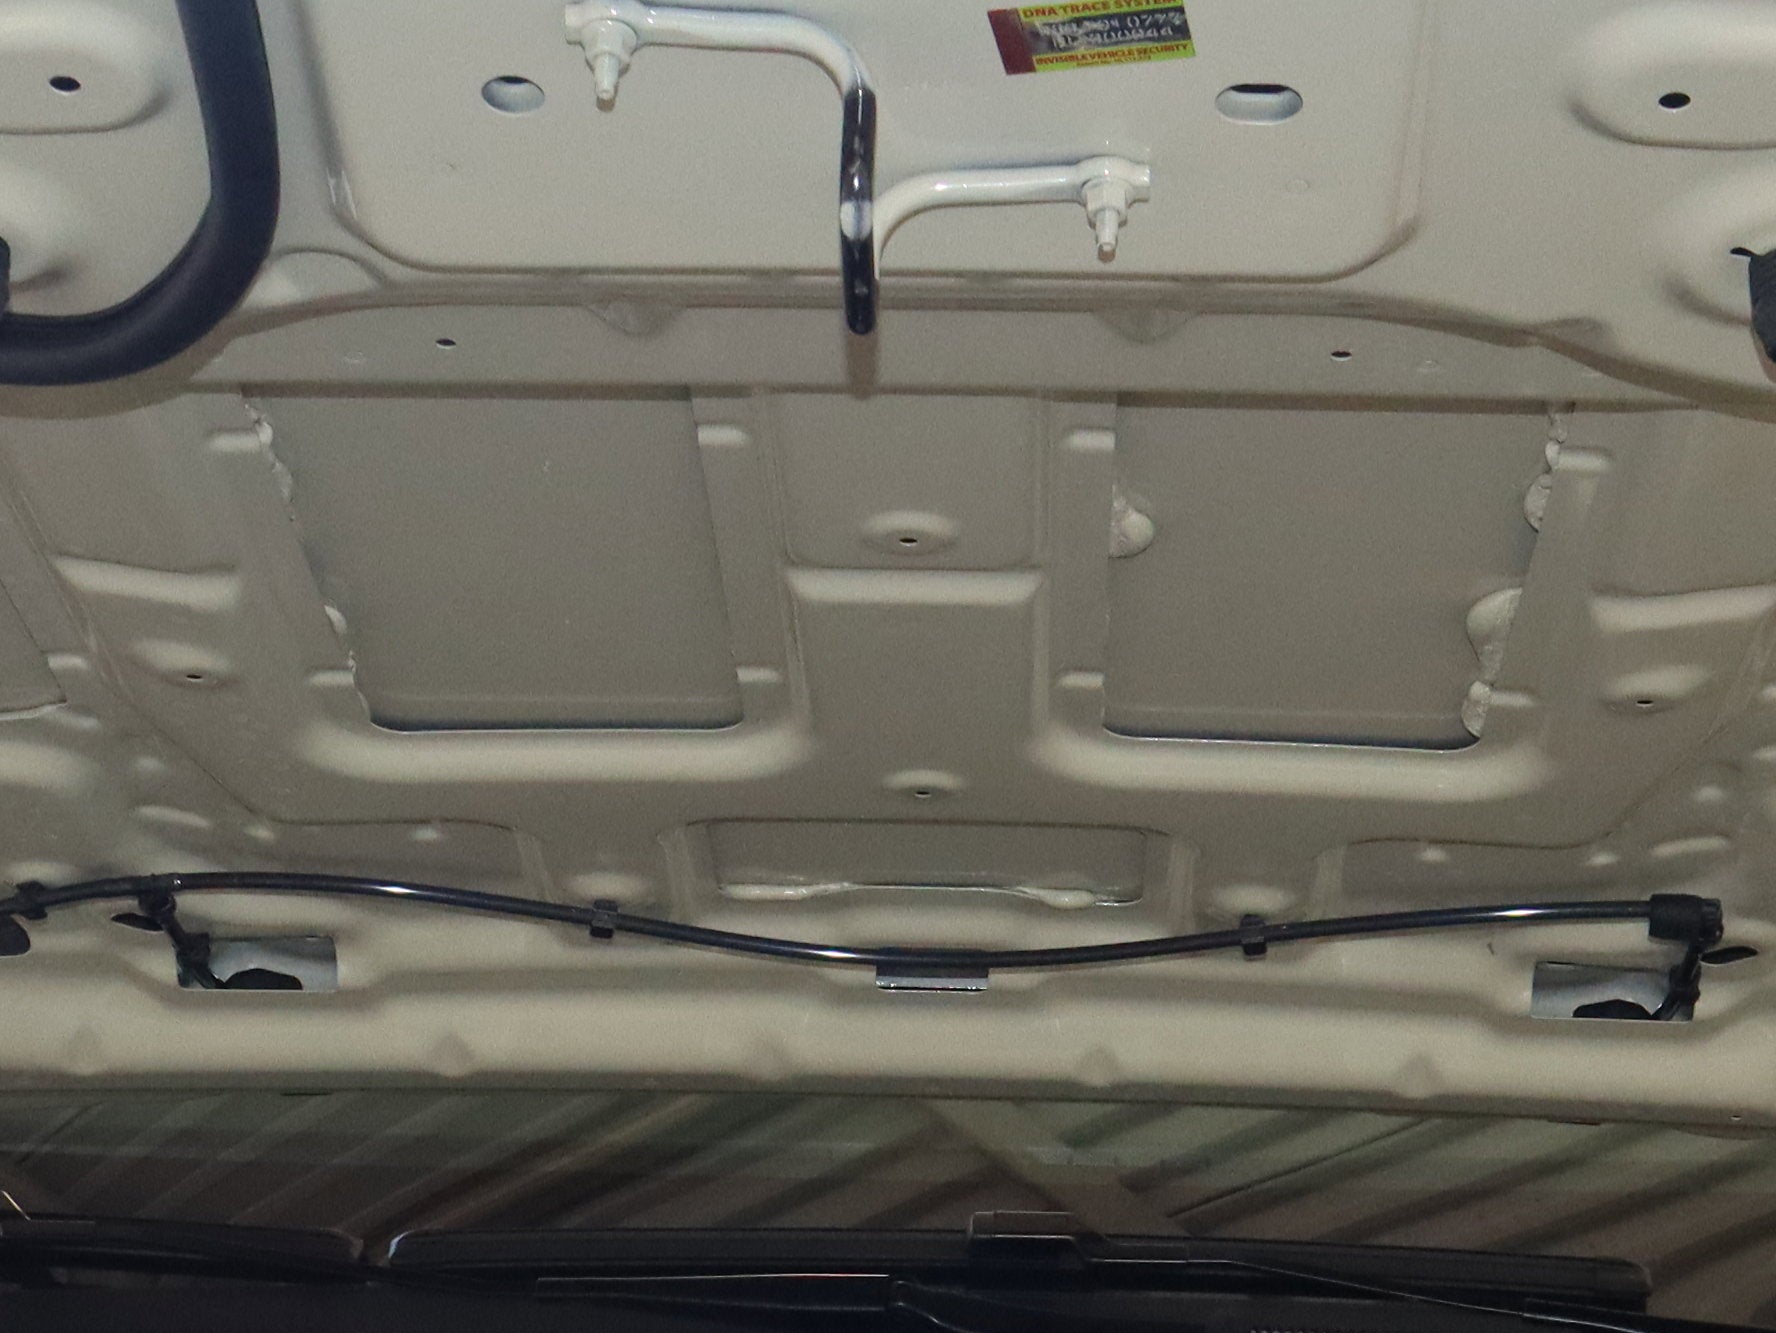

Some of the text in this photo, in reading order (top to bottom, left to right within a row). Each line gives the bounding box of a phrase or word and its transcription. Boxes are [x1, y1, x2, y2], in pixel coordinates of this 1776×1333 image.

[1022, 0, 1177, 18] DNA TRACE SYST
